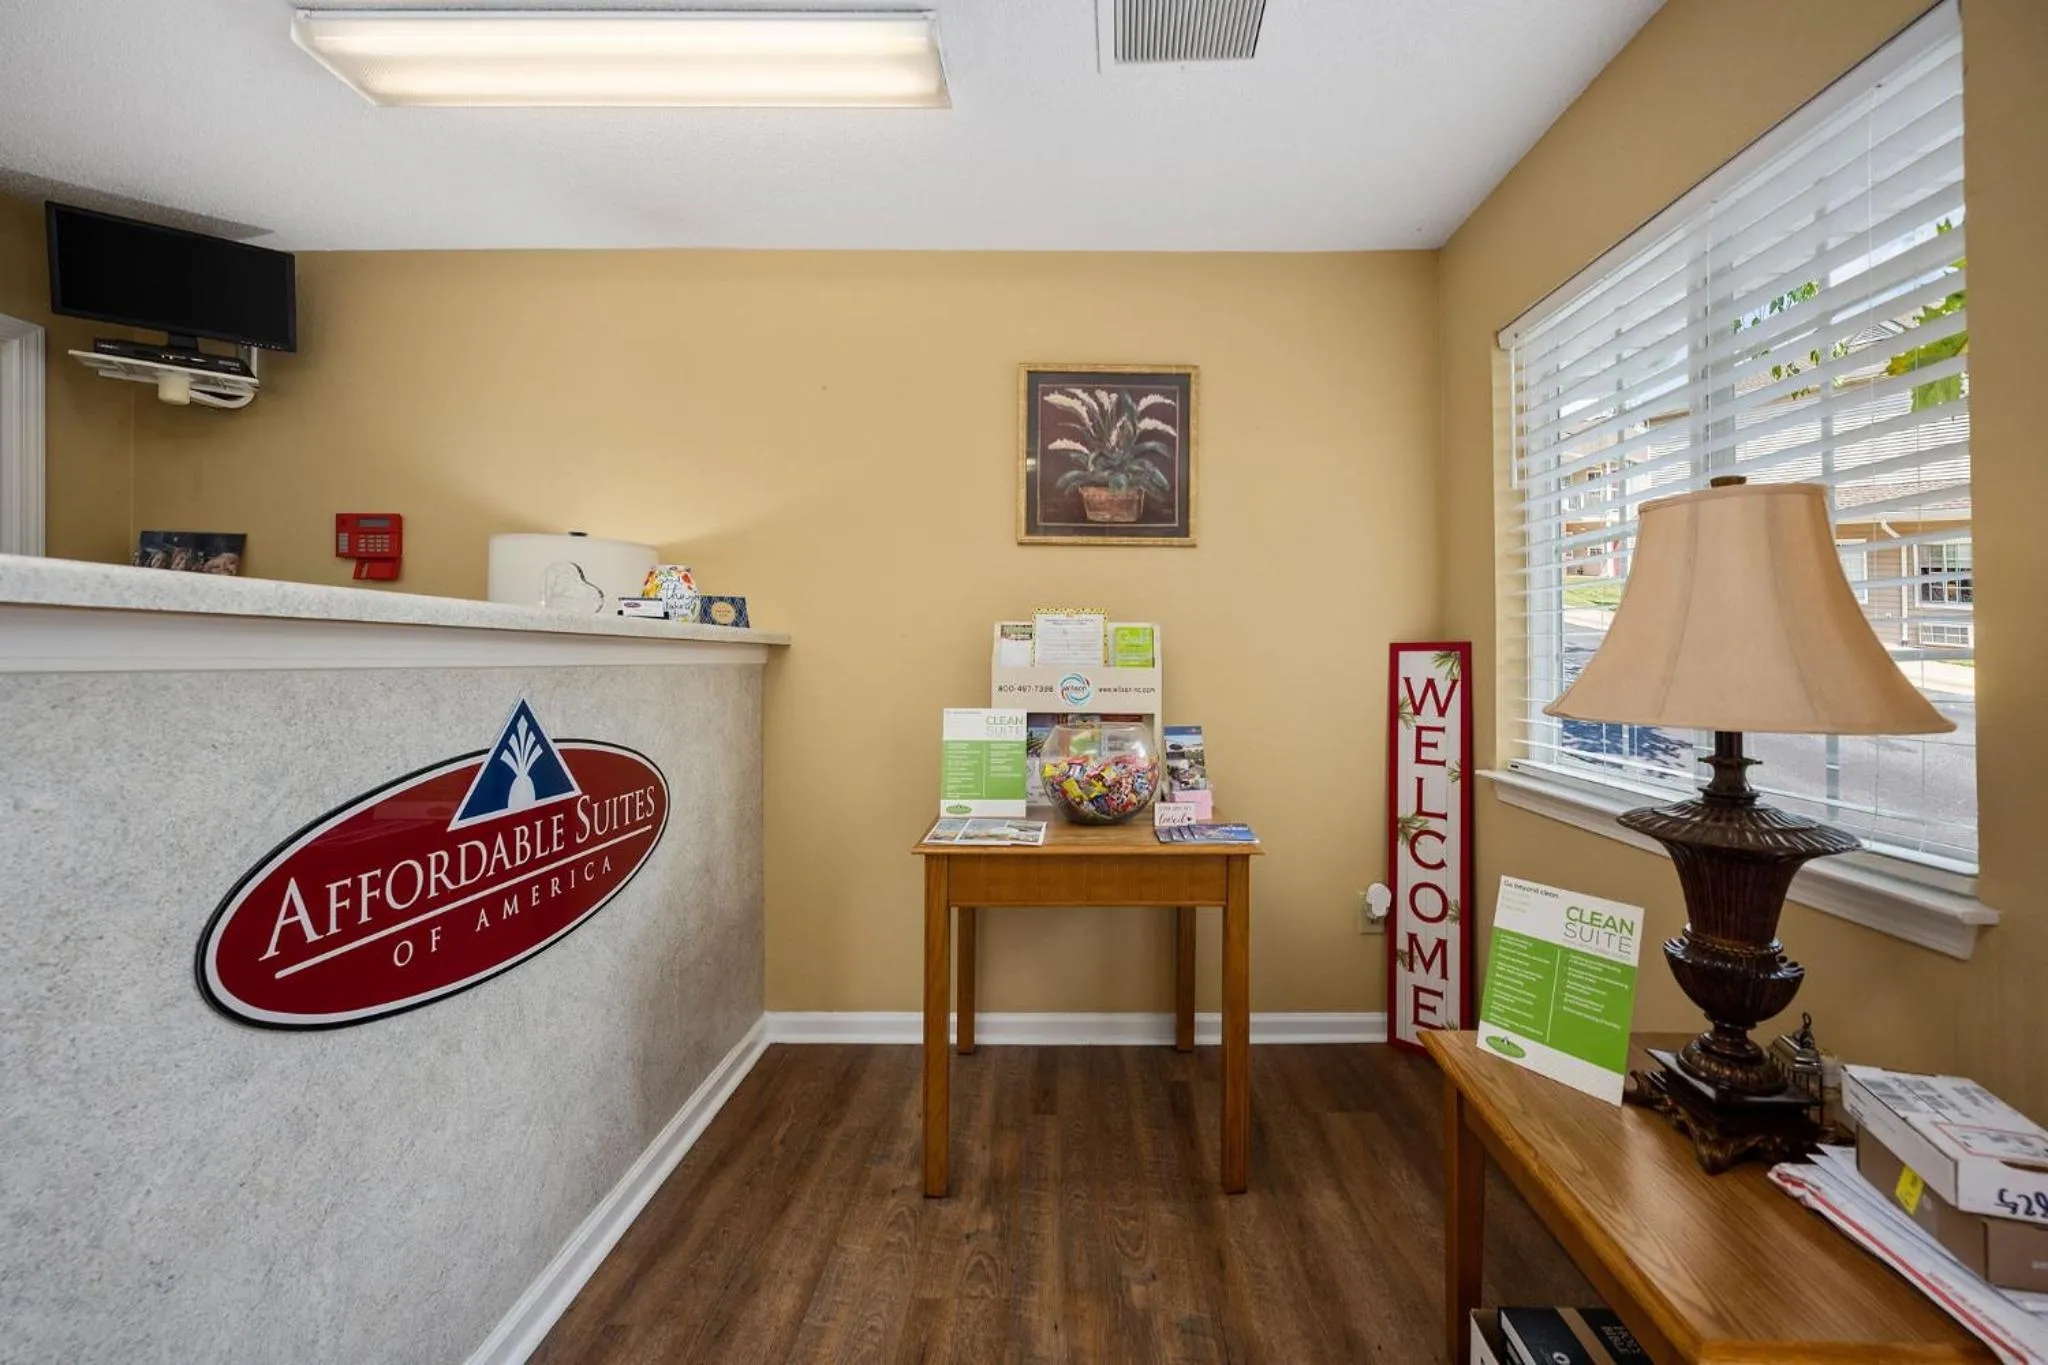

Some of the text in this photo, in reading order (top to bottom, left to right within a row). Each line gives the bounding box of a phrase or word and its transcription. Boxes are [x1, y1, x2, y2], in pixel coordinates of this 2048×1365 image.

[986, 715, 1024, 726] CLEAN
[986, 725, 1024, 737] SUITE
[1402, 676, 1459, 1031] WELCOME
[257, 784, 656, 962] AFFORDABLE SUITES
[1503, 879, 1514, 889] Go
[1514, 882, 1540, 896] beyond
[1540, 887, 1559, 900] clean
[392, 856, 613, 968] OF AMERICA
[1565, 905, 1635, 937] CLEAN
[1563, 921, 1633, 956] SUITE
